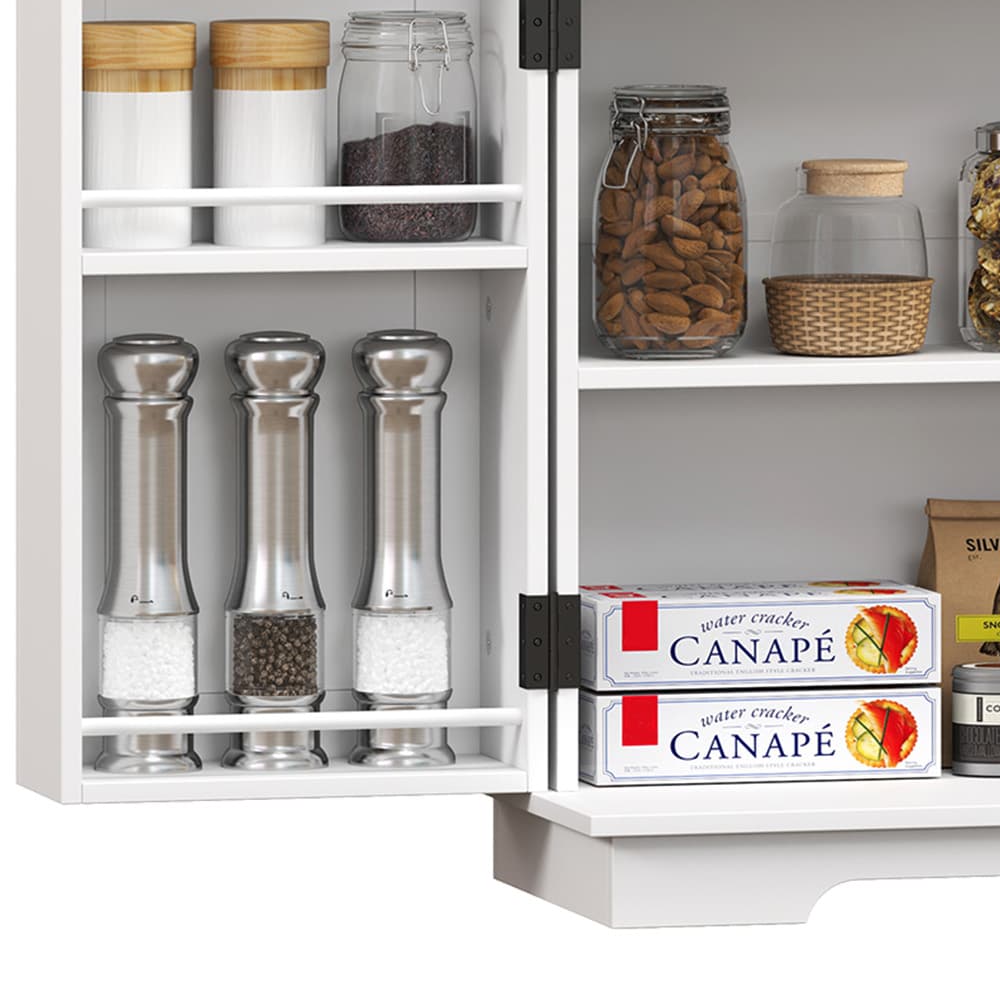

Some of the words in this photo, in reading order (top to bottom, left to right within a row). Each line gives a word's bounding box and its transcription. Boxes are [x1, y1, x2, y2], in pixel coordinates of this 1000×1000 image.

[701, 612, 746, 633] water
[751, 611, 810, 630] cracker
[669, 628, 836, 666] CANAPÉ
[701, 707, 746, 728] water
[751, 706, 810, 725] cracker
[669, 723, 836, 761] CANAPÉ
